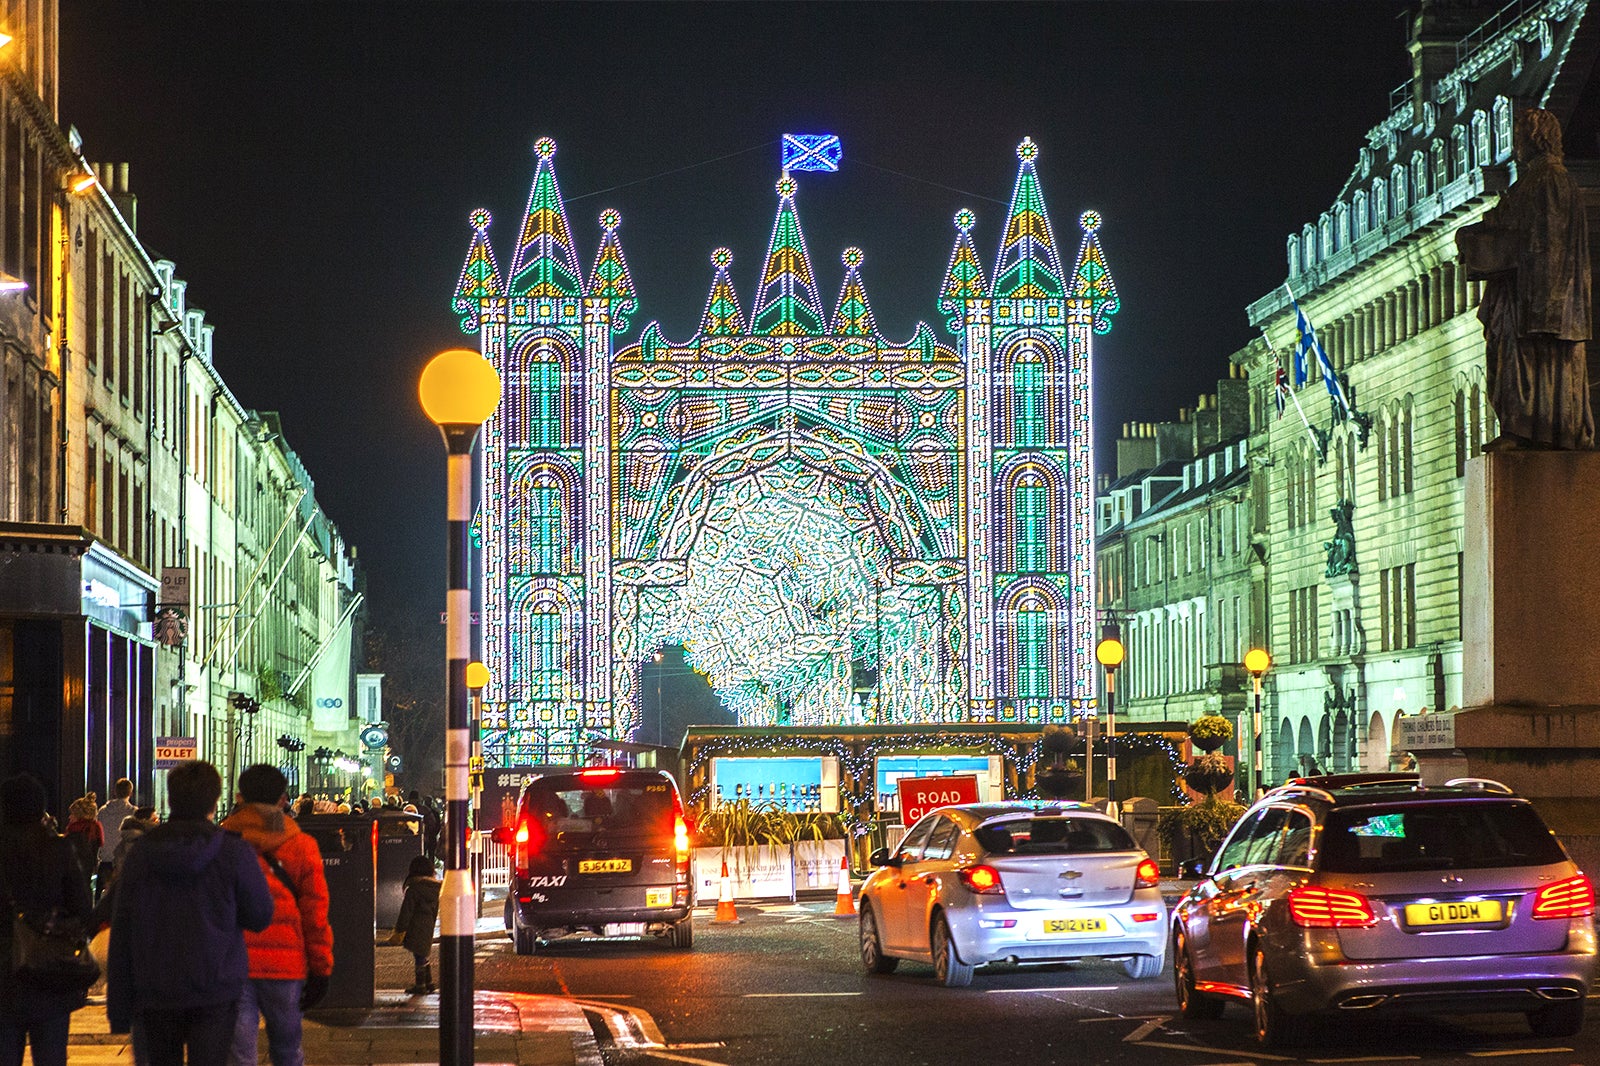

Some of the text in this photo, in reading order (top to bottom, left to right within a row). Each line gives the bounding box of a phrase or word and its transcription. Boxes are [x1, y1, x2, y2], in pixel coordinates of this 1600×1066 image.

[174, 576, 187, 585] LET
[157, 749, 192, 757] TO LET
[917, 791, 961, 804] ROAD
[742, 864, 785, 872] EDINBURGH
[530, 875, 567, 887] TAXI
